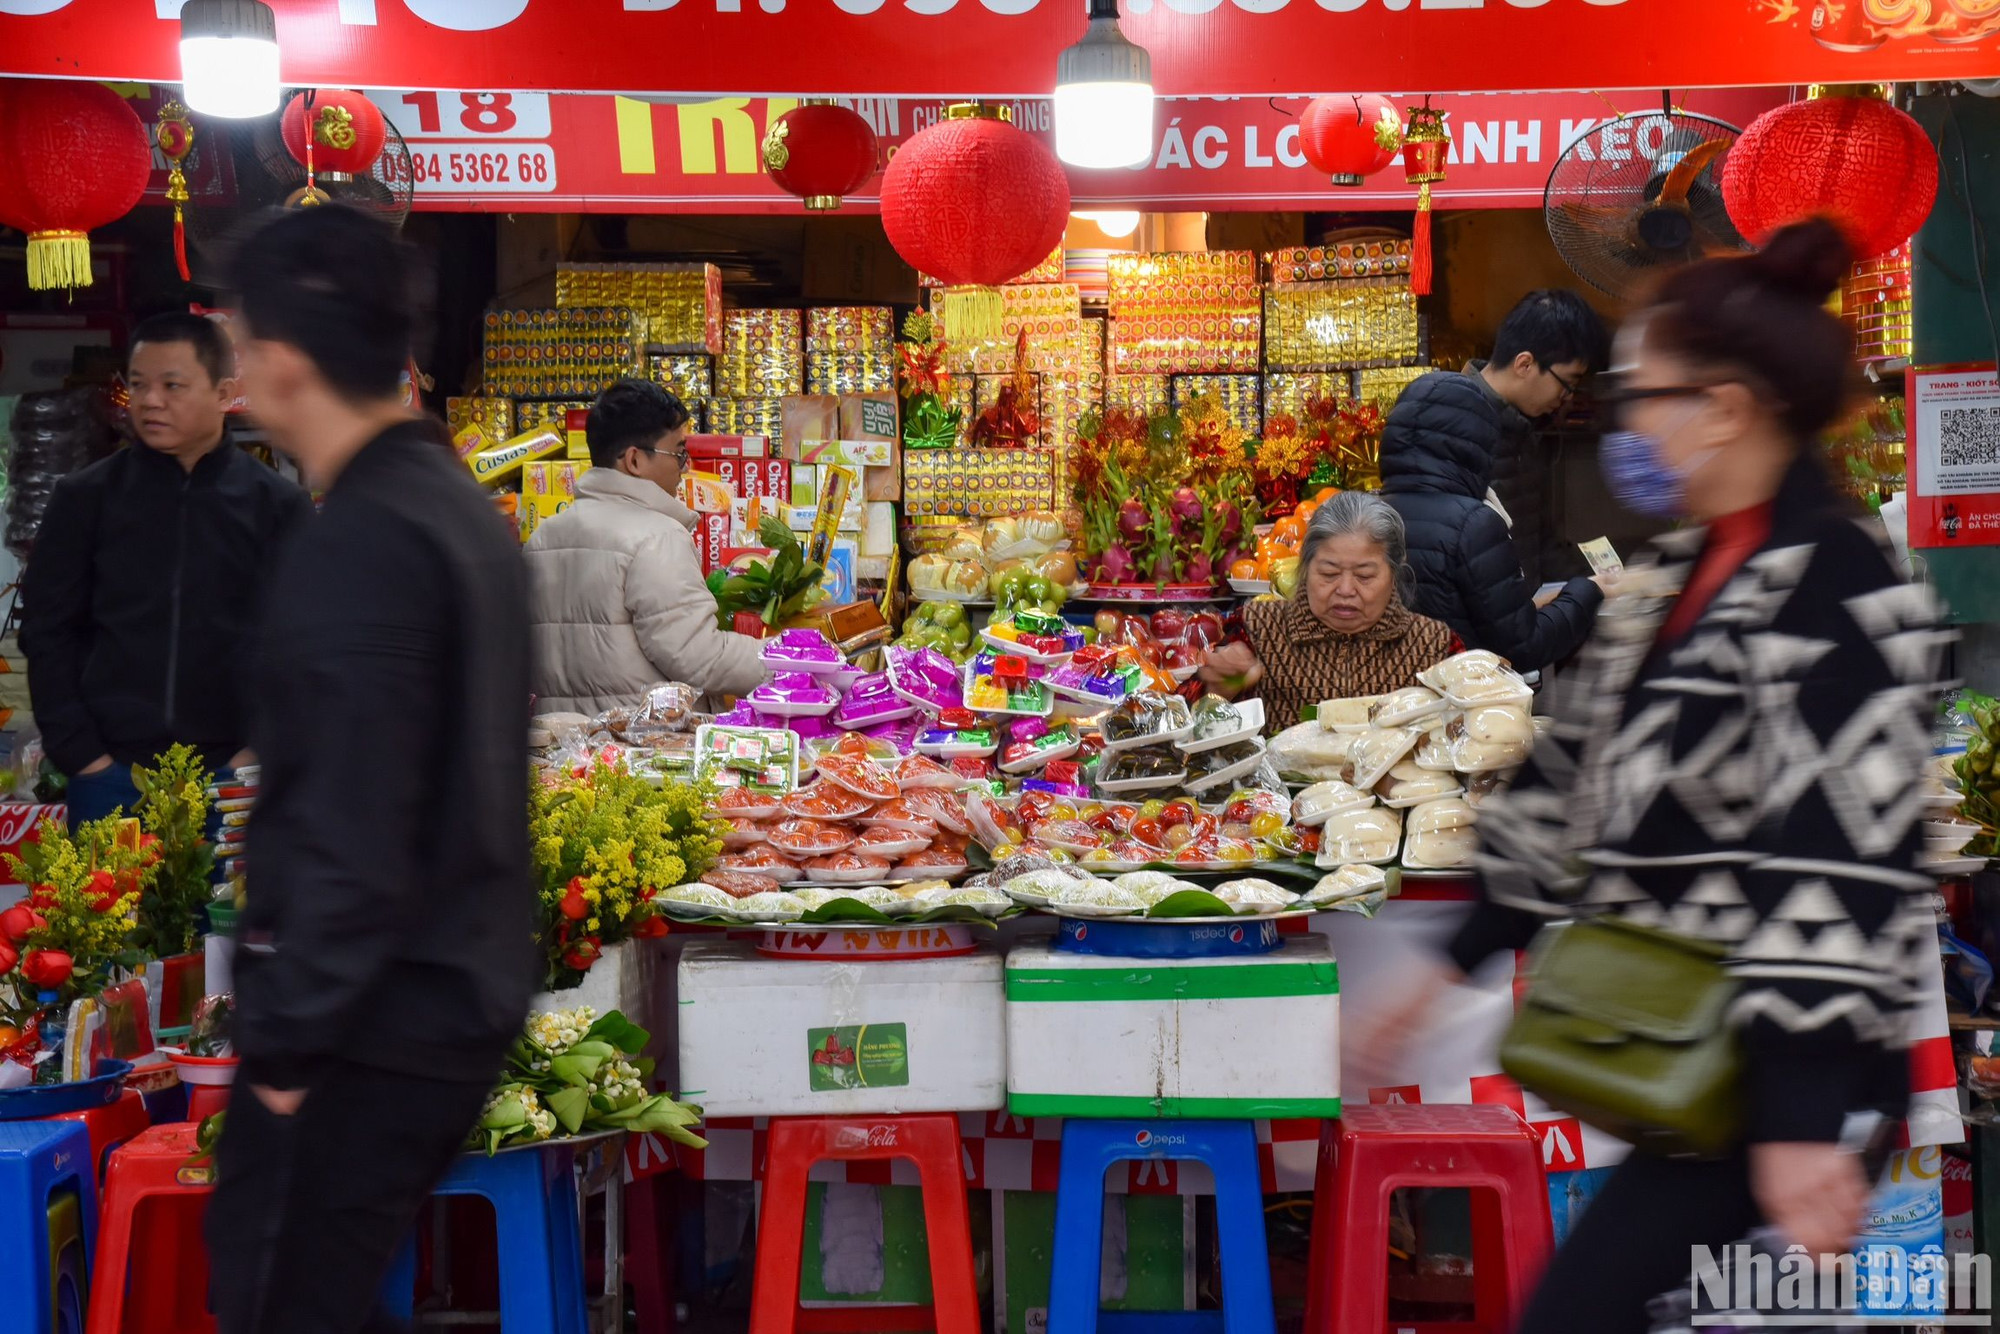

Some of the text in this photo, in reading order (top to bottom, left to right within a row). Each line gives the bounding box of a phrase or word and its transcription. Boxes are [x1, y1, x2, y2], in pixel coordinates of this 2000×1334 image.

[1129, 117, 1229, 170] ÁC
[383, 153, 548, 183] 0984 5362 68
[475, 446, 528, 474] Custas
[737, 506, 745, 522] AFC
[1153, 1133, 1187, 1147] pepsi
[1909, 1209, 1917, 1219] K
